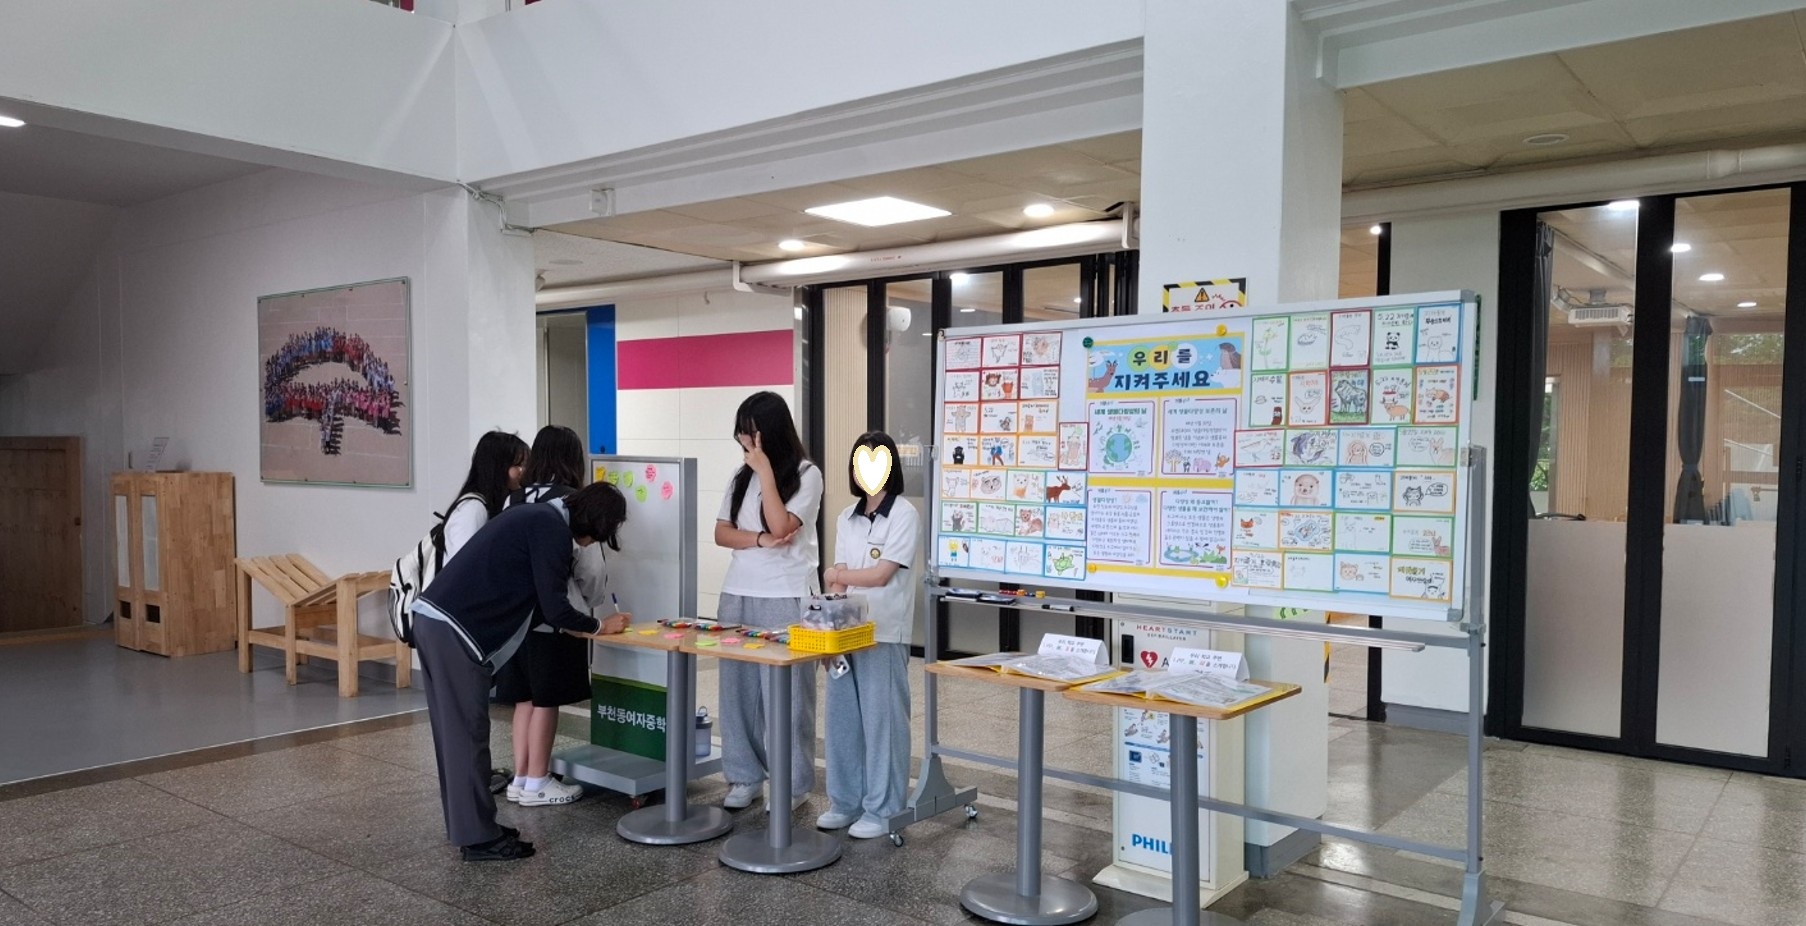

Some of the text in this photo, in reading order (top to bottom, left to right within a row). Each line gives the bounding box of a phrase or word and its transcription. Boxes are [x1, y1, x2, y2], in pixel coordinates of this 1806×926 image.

[1132, 348, 1192, 366] 우리를
[1114, 370, 1211, 390] 지켜주세요
[1136, 624, 1197, 636] HEARTSTART
[597, 704, 667, 733] 부천동여자중학
[1132, 833, 1173, 856] PHIL
